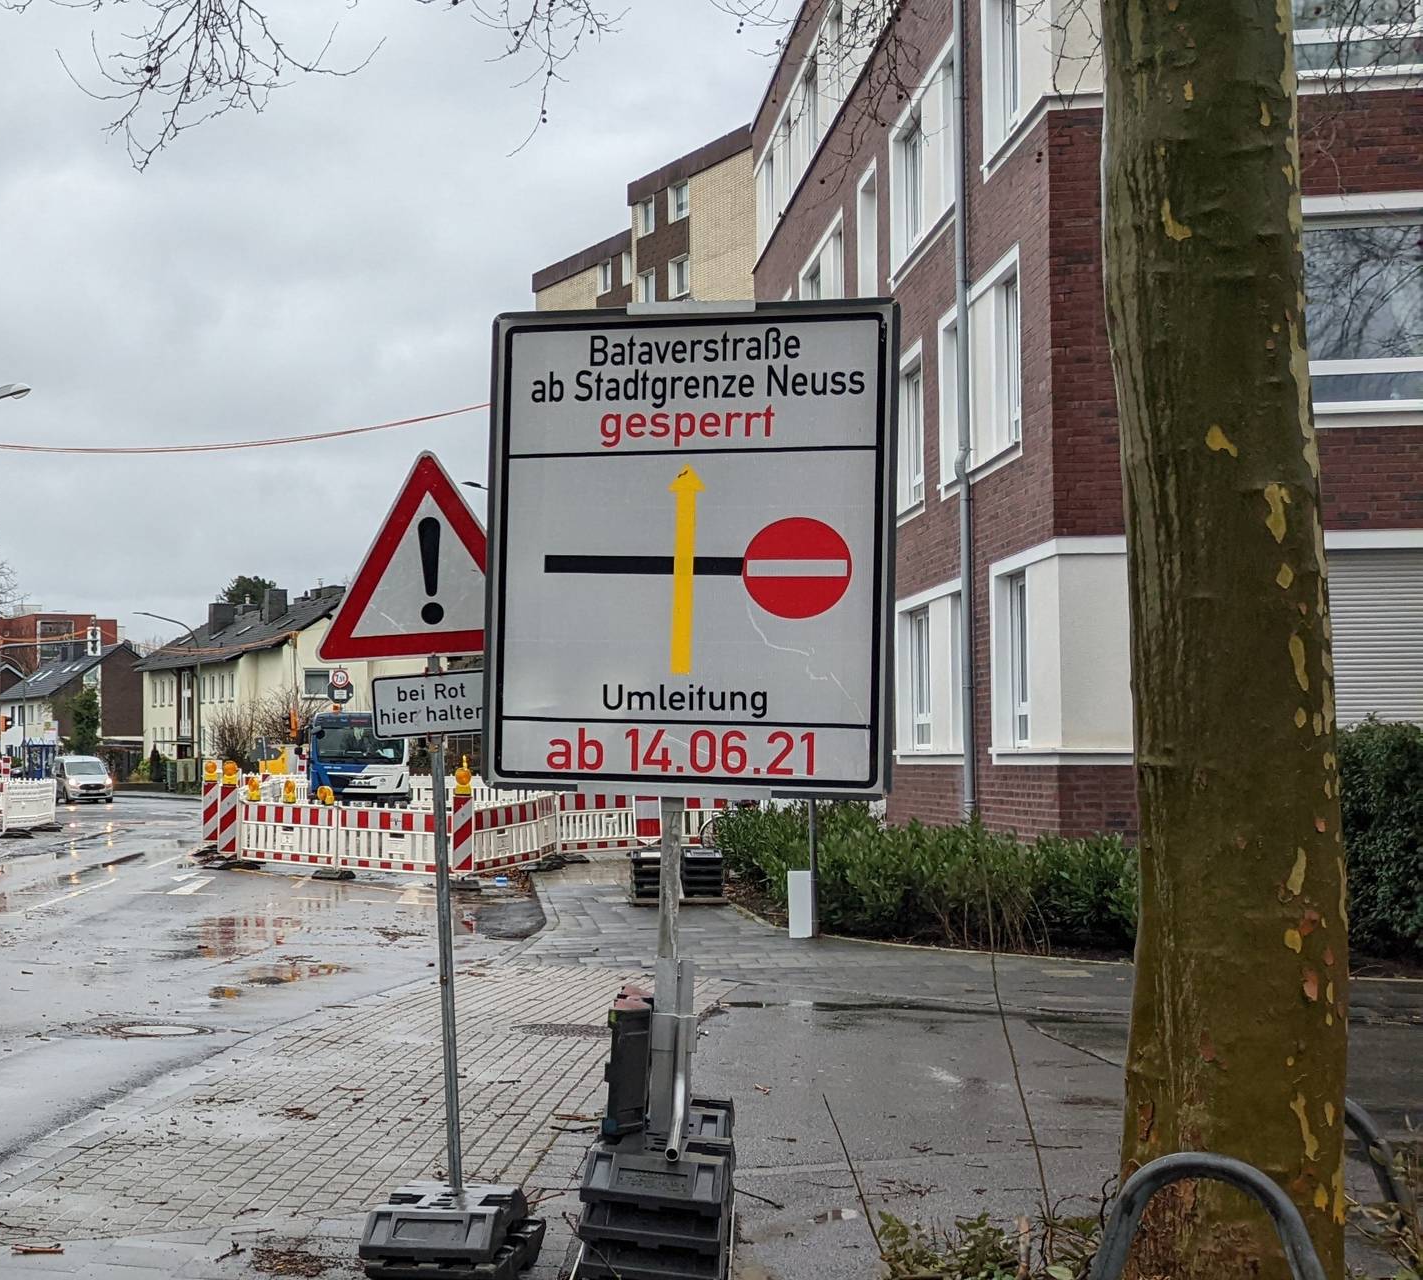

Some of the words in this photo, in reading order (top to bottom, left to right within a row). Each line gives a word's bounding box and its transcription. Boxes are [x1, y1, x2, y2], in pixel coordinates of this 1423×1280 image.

[589, 327, 801, 367] Bataverstraße
[530, 370, 565, 404] ab
[574, 368, 755, 409] Stadtgrenze
[766, 364, 865, 398] Neuss
[599, 404, 776, 448] gesperrt
[397, 685, 425, 702] bei
[434, 683, 466, 700] Rot
[602, 683, 769, 718] Umleitung
[380, 708, 417, 725] hier
[546, 727, 604, 773] ab
[624, 728, 816, 776] 14.06.21
